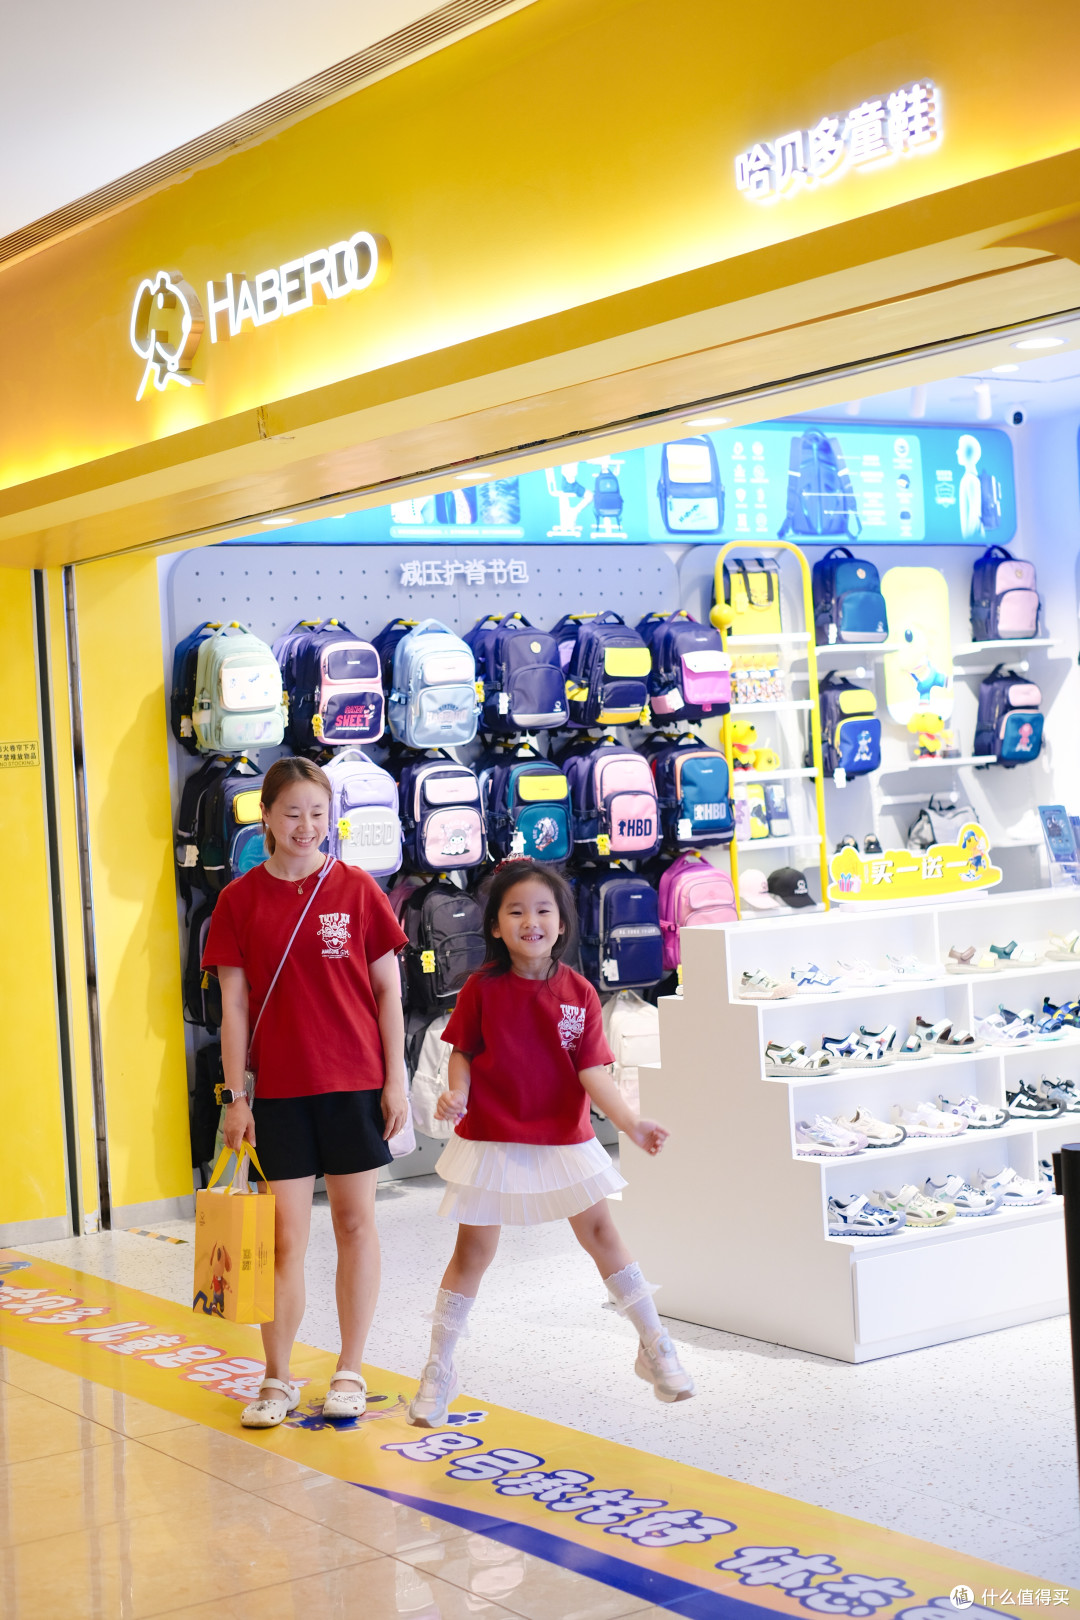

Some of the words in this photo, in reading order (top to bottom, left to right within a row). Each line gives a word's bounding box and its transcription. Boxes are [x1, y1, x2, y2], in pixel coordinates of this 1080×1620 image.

[735, 83, 938, 197] 哈贝多童鞋
[207, 231, 379, 344] HABERDO
[400, 558, 529, 587] 减压护脊书包
[335, 714, 370, 727] SWEET
[705, 803, 727, 821] HBD
[361, 821, 395, 847] HBD
[627, 819, 653, 837] HBD
[872, 856, 969, 885] 买一送一
[381, 1432, 737, 1547] 足弓承托好
